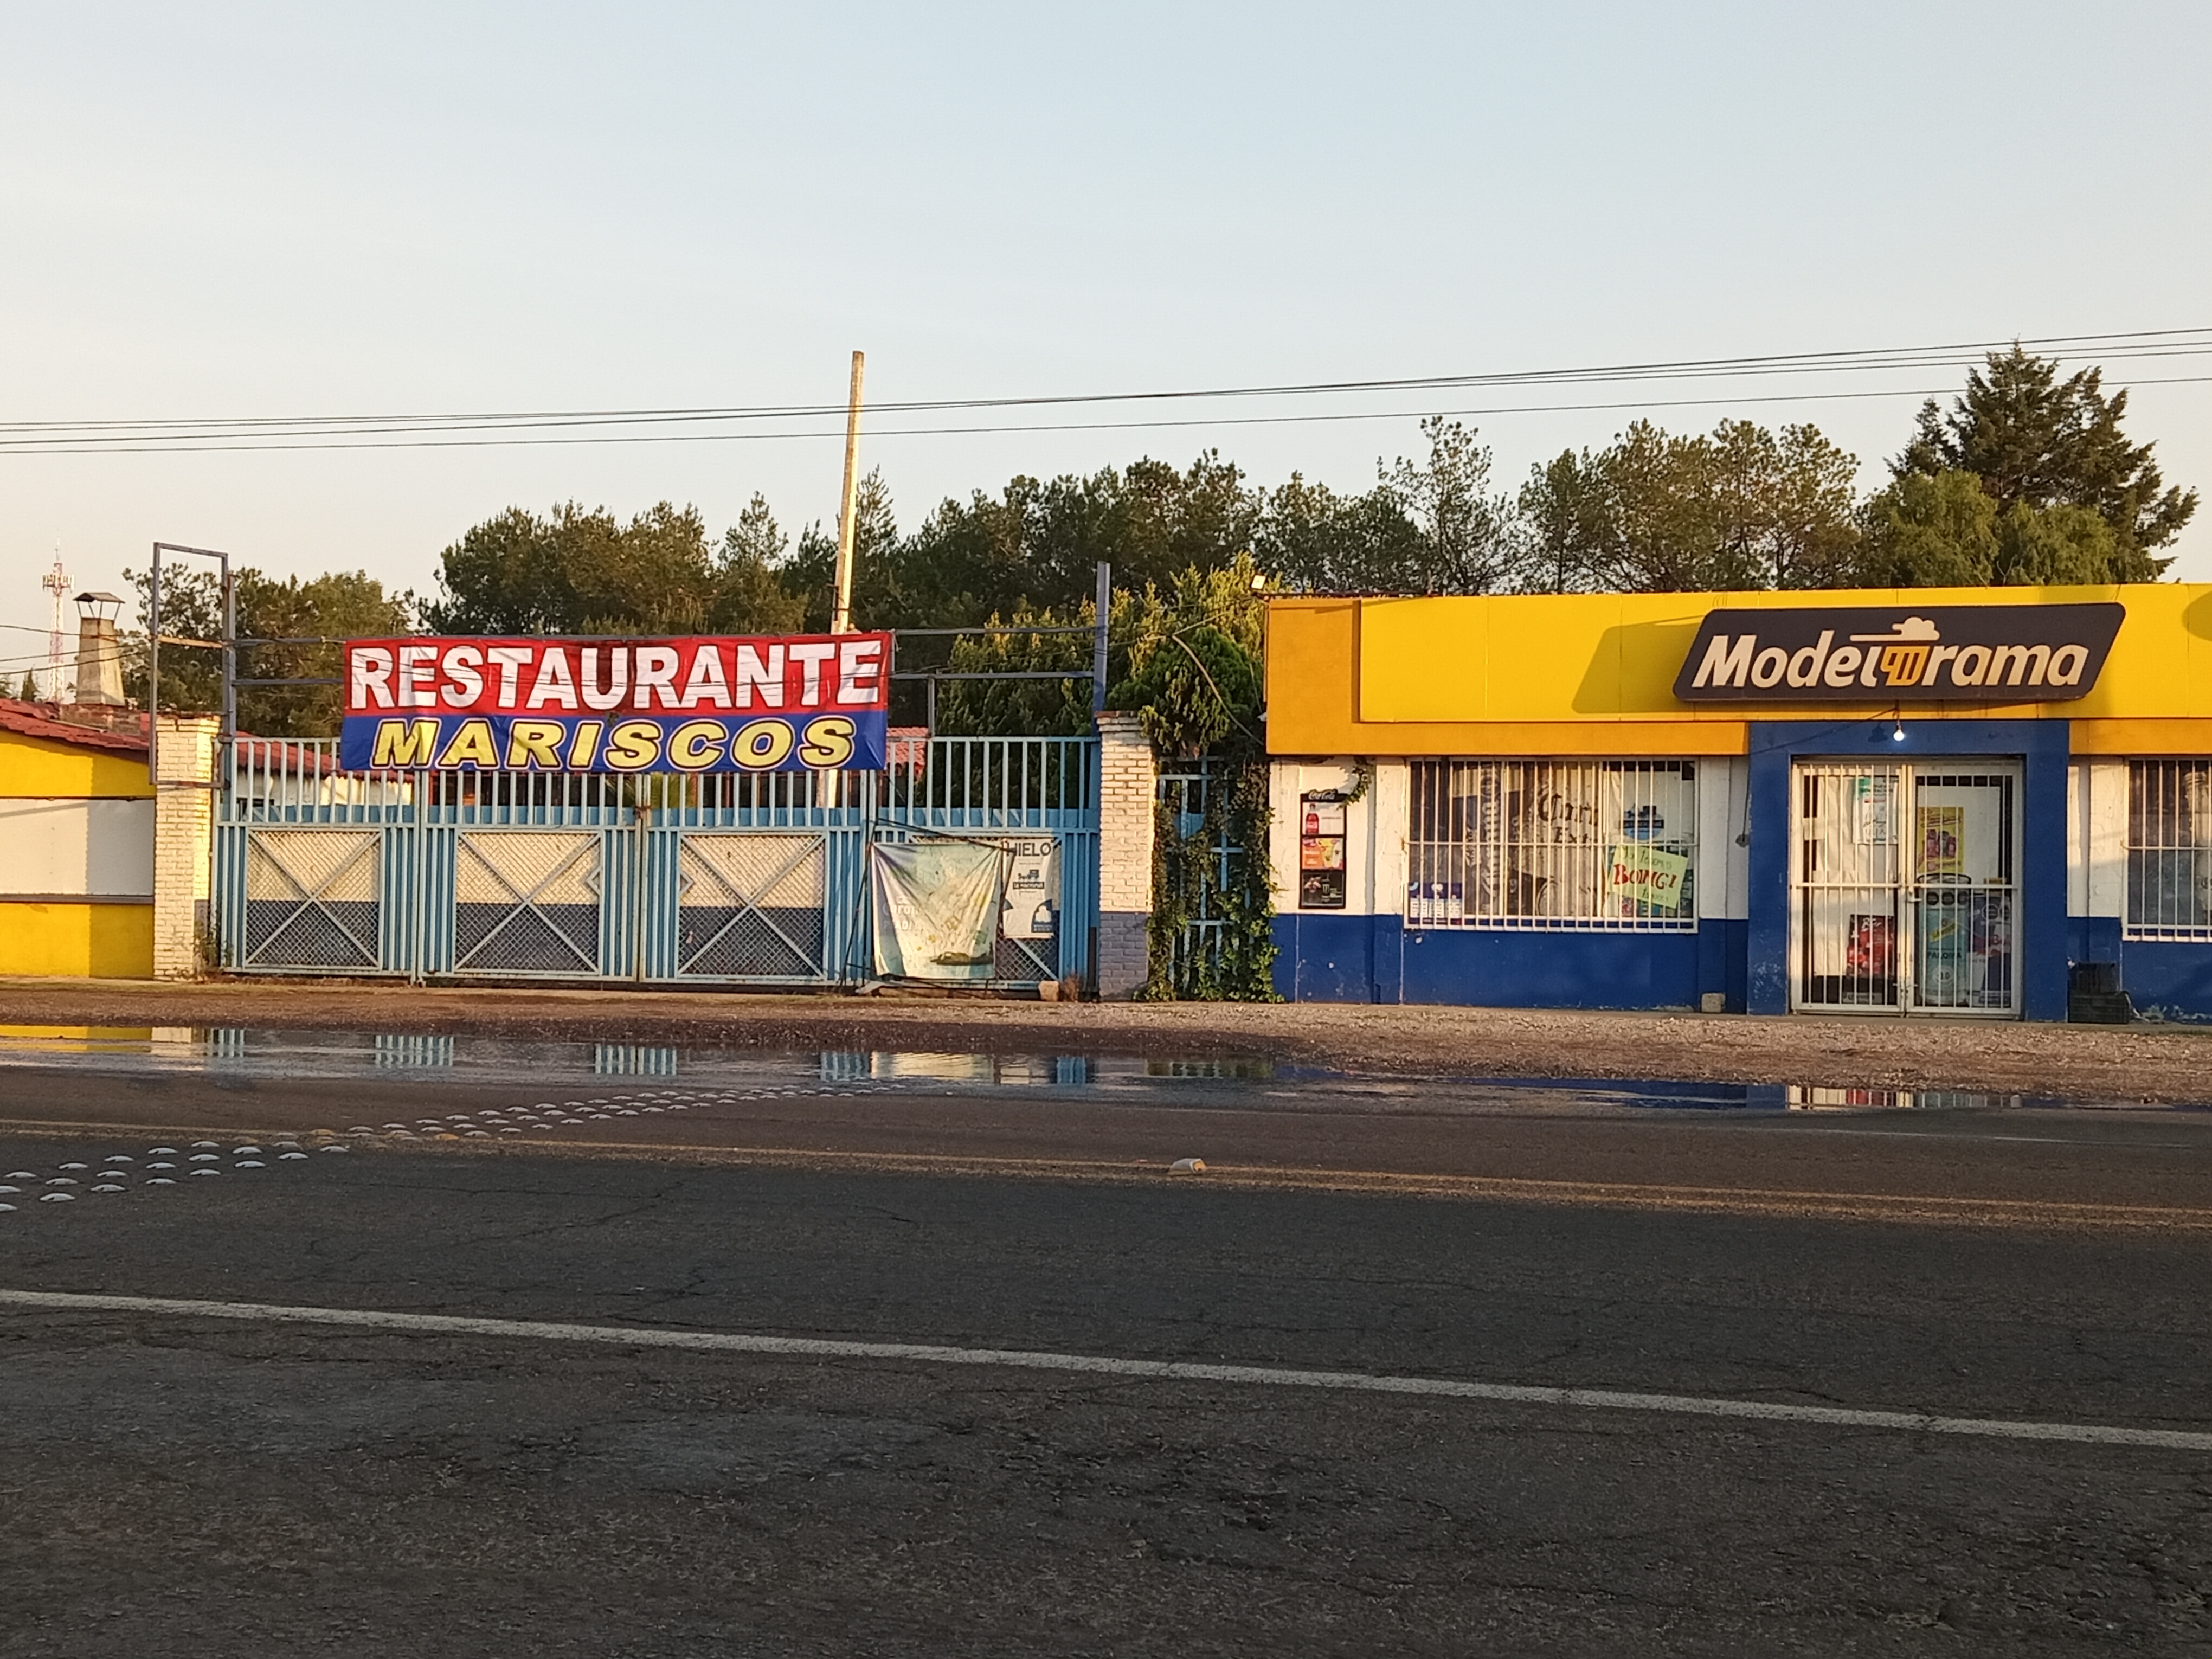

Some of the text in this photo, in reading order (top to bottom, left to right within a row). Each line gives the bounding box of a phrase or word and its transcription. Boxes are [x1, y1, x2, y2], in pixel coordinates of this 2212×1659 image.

[350, 639, 883, 710] RESTAURANTE
[371, 715, 857, 771] MARISCOS
[1007, 842, 1052, 857] HIELO
